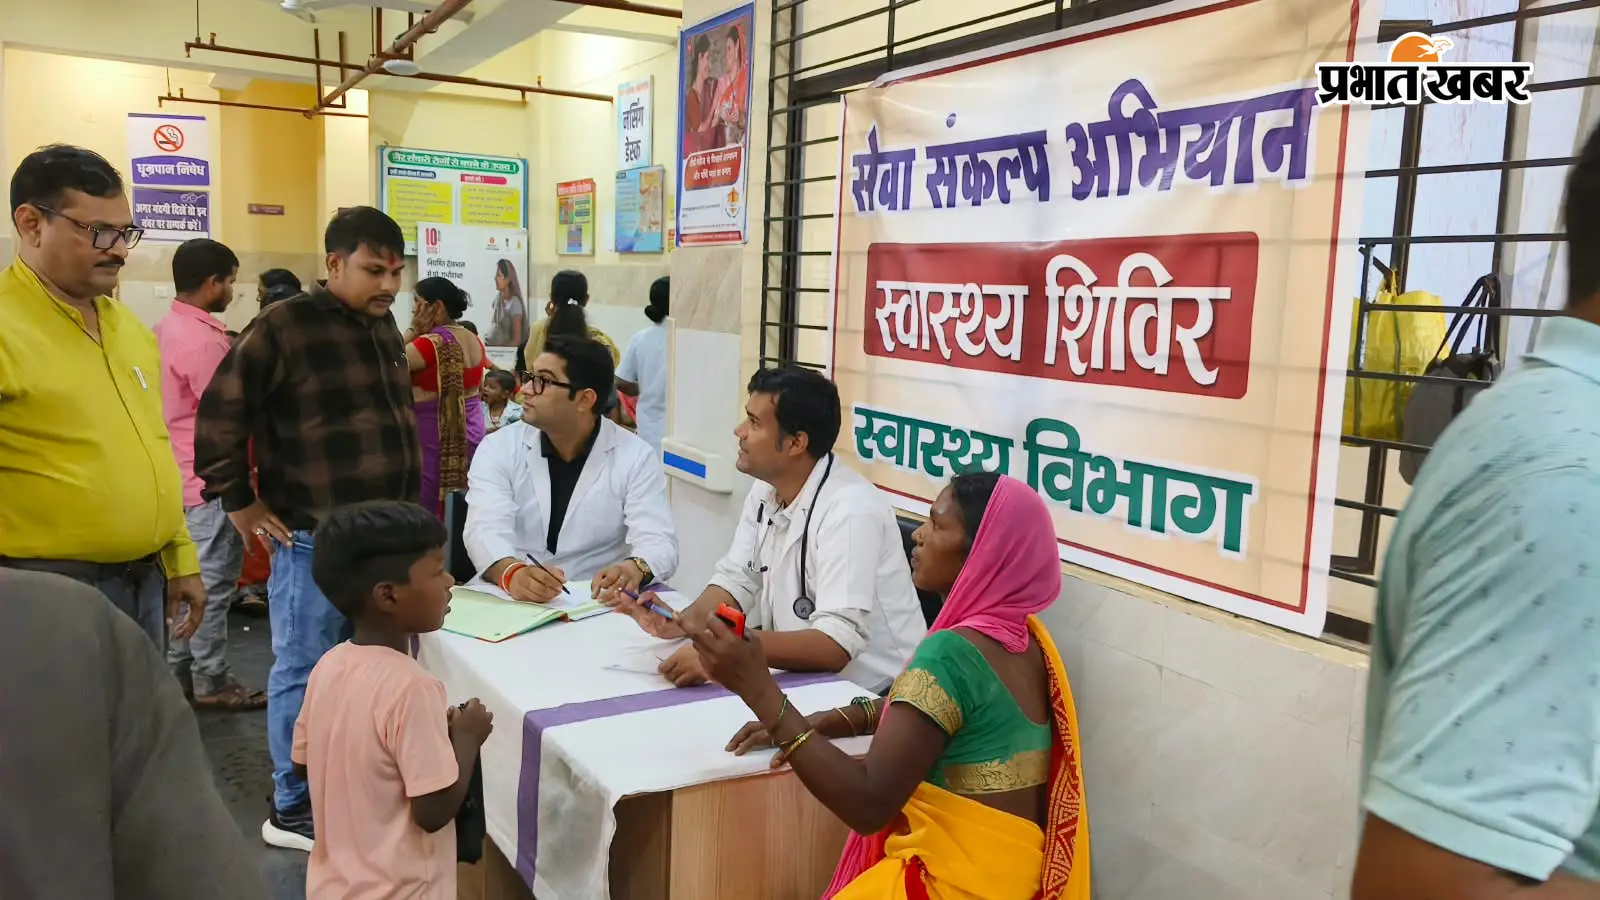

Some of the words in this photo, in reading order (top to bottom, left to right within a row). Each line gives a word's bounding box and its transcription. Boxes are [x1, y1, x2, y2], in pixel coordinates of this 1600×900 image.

[624, 136, 641, 162] डेस्क
[852, 126, 916, 212] सेवा
[926, 113, 1050, 208] संकल्प
[1066, 79, 1318, 201] अभियान
[136, 163, 175, 177] धूम्रपान
[176, 161, 205, 176] निषेध
[135, 203, 152, 214] अगर
[153, 202, 170, 215] गंदगी
[187, 204, 196, 216] तो
[197, 206, 207, 217] इन
[141, 216, 155, 228] नंबर
[156, 219, 166, 229] पर
[876, 281, 1029, 362] स्वास्थ्य
[1044, 252, 1231, 386] शिविर
[854, 407, 1014, 477] स्वास्थ्य
[1023, 418, 1252, 552] विभाग
